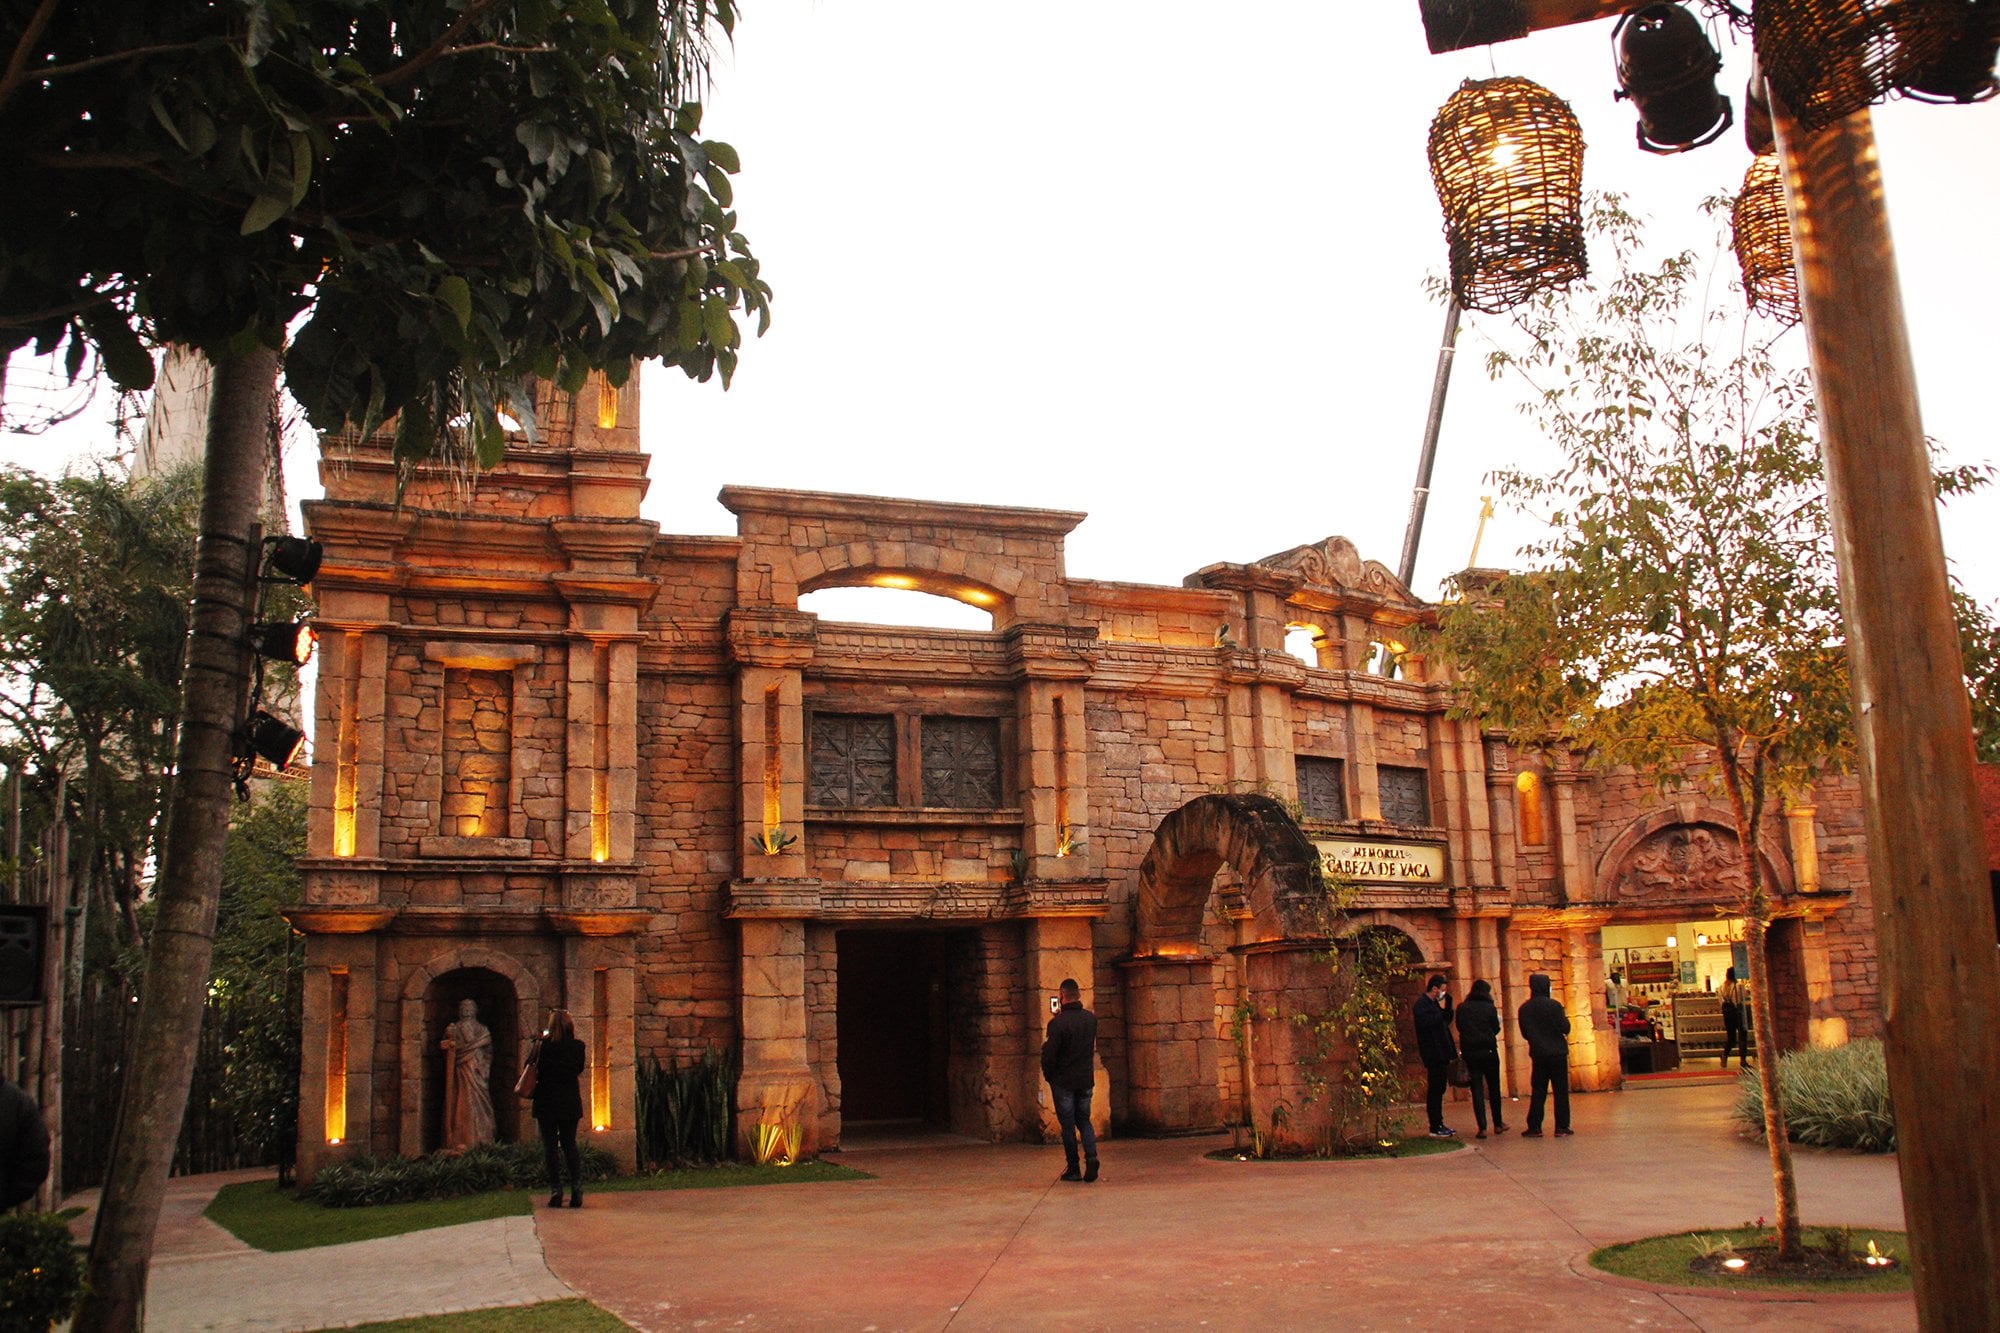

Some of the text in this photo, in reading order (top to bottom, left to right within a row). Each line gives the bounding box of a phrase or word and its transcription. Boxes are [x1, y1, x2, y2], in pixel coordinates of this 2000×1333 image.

[1353, 847, 1405, 859] MEMORIAL
[1327, 859, 1430, 877] CABEZA DE VACA
